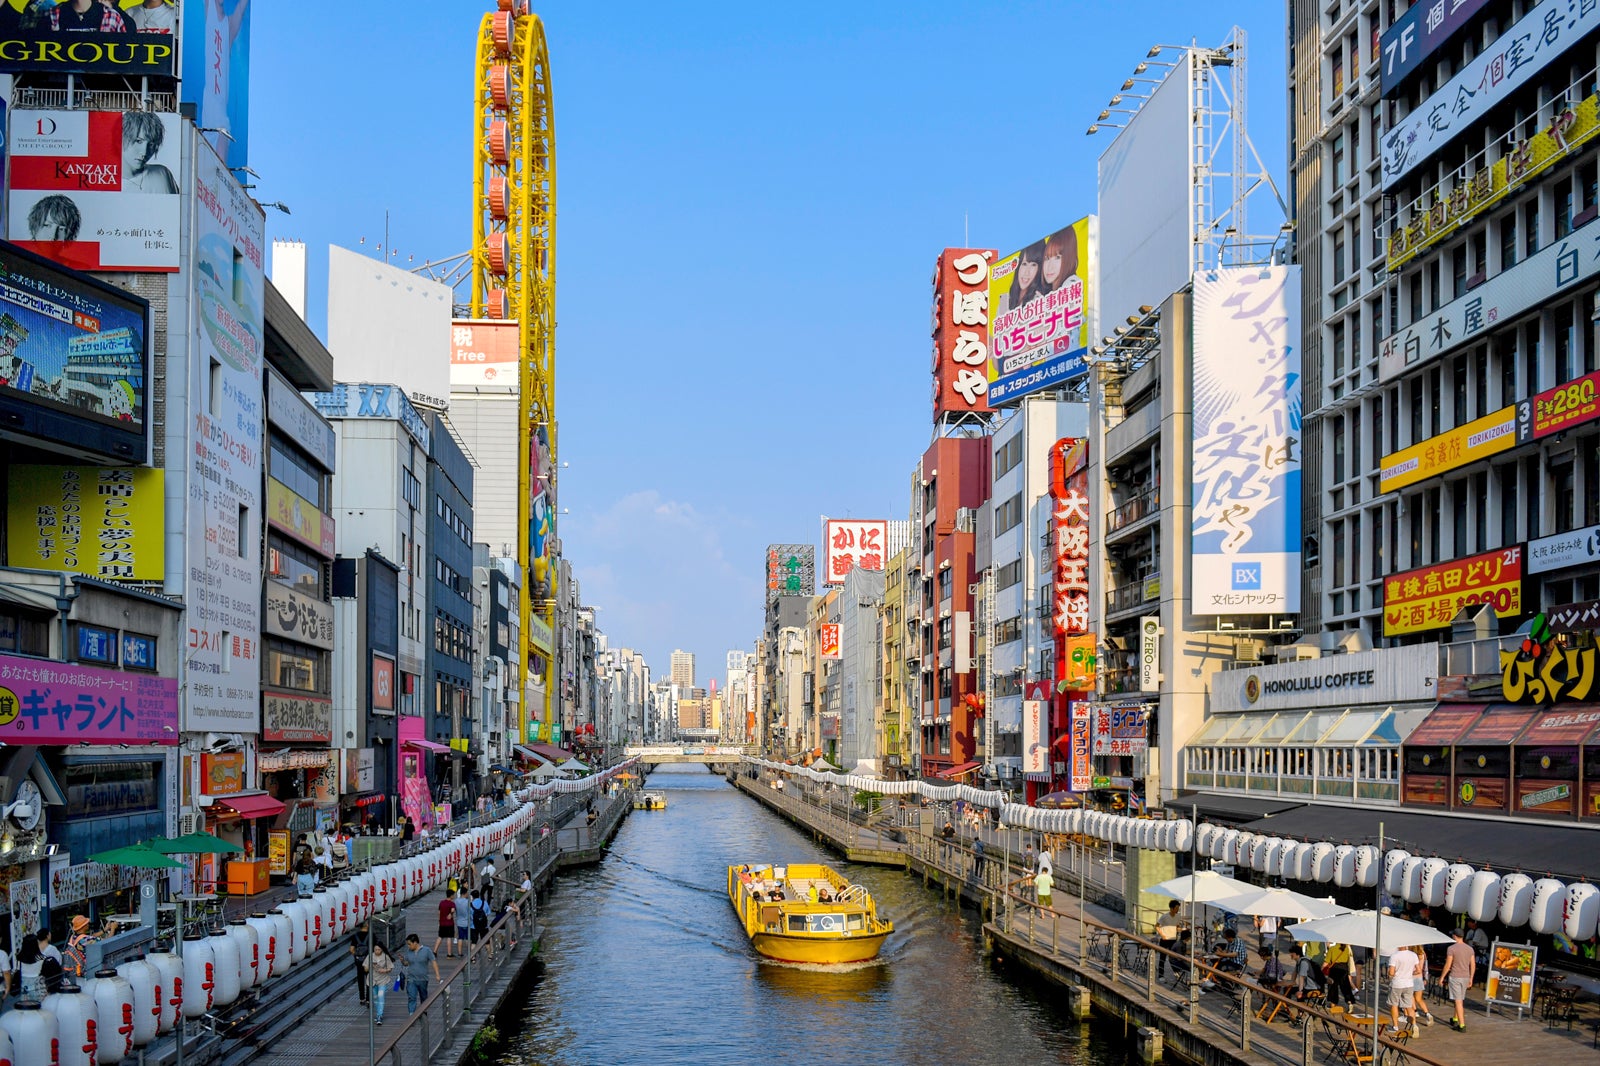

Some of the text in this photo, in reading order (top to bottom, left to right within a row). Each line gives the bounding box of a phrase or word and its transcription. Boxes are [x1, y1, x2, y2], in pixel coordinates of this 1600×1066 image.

[0, 40, 171, 65] GROUP
[1385, 22, 1415, 76] 7F
[55, 161, 117, 178] KANZAKI
[78, 173, 117, 188] RUKA
[97, 228, 164, 237] めっちゃ面白いを
[144, 240, 173, 250] 仕事に。
[993, 281, 1082, 334] 高収入お仕事情報
[453, 327, 473, 346] 税
[952, 251, 993, 405] づぼらや
[994, 300, 1082, 357] いちごナビ
[1382, 296, 1485, 367] 4F 白木屋
[457, 350, 485, 361] Free
[1005, 352, 1035, 370] いちごナビ
[412, 391, 446, 406] 意匠作成中
[1468, 423, 1511, 446] TORIKIZOKU
[1424, 436, 1461, 470] 鳥貴族
[1381, 459, 1415, 481] TORIKIZOKU
[62, 470, 81, 568] あなたのお店づくり
[98, 470, 134, 578] 素晴らしい夢の実現
[36, 505, 57, 560] 応援します
[832, 526, 880, 551] かに
[1055, 489, 1088, 632] 大阪王将
[1530, 546, 1548, 560] 大阪
[1550, 538, 1582, 555] お好み焼
[832, 553, 881, 576] 道楽
[1236, 569, 1258, 583] BX
[1386, 557, 1502, 604] 豊後高田どり
[1503, 547, 1520, 567] 2F
[1403, 599, 1453, 628] 酒場
[1549, 602, 1599, 628] ハンバ
[88, 631, 99, 658] 酒
[189, 628, 257, 660] コスパ 最高!
[822, 628, 830, 650] ドラッグ
[829, 625, 837, 645] ツルハ
[124, 639, 146, 664] たばこ
[1145, 636, 1153, 664] ZERO
[1, 664, 133, 692] あなたも憧れのお店のオーナーに!
[193, 683, 213, 698] 予約受付
[1264, 670, 1375, 694] HONOLULU COFFEE
[17, 720, 25, 731] の
[21, 688, 135, 732] ギャラント
[1098, 708, 1145, 735] 薬 ダイコク
[1075, 720, 1087, 756] ダイコク
[1111, 740, 1131, 753] 免税
